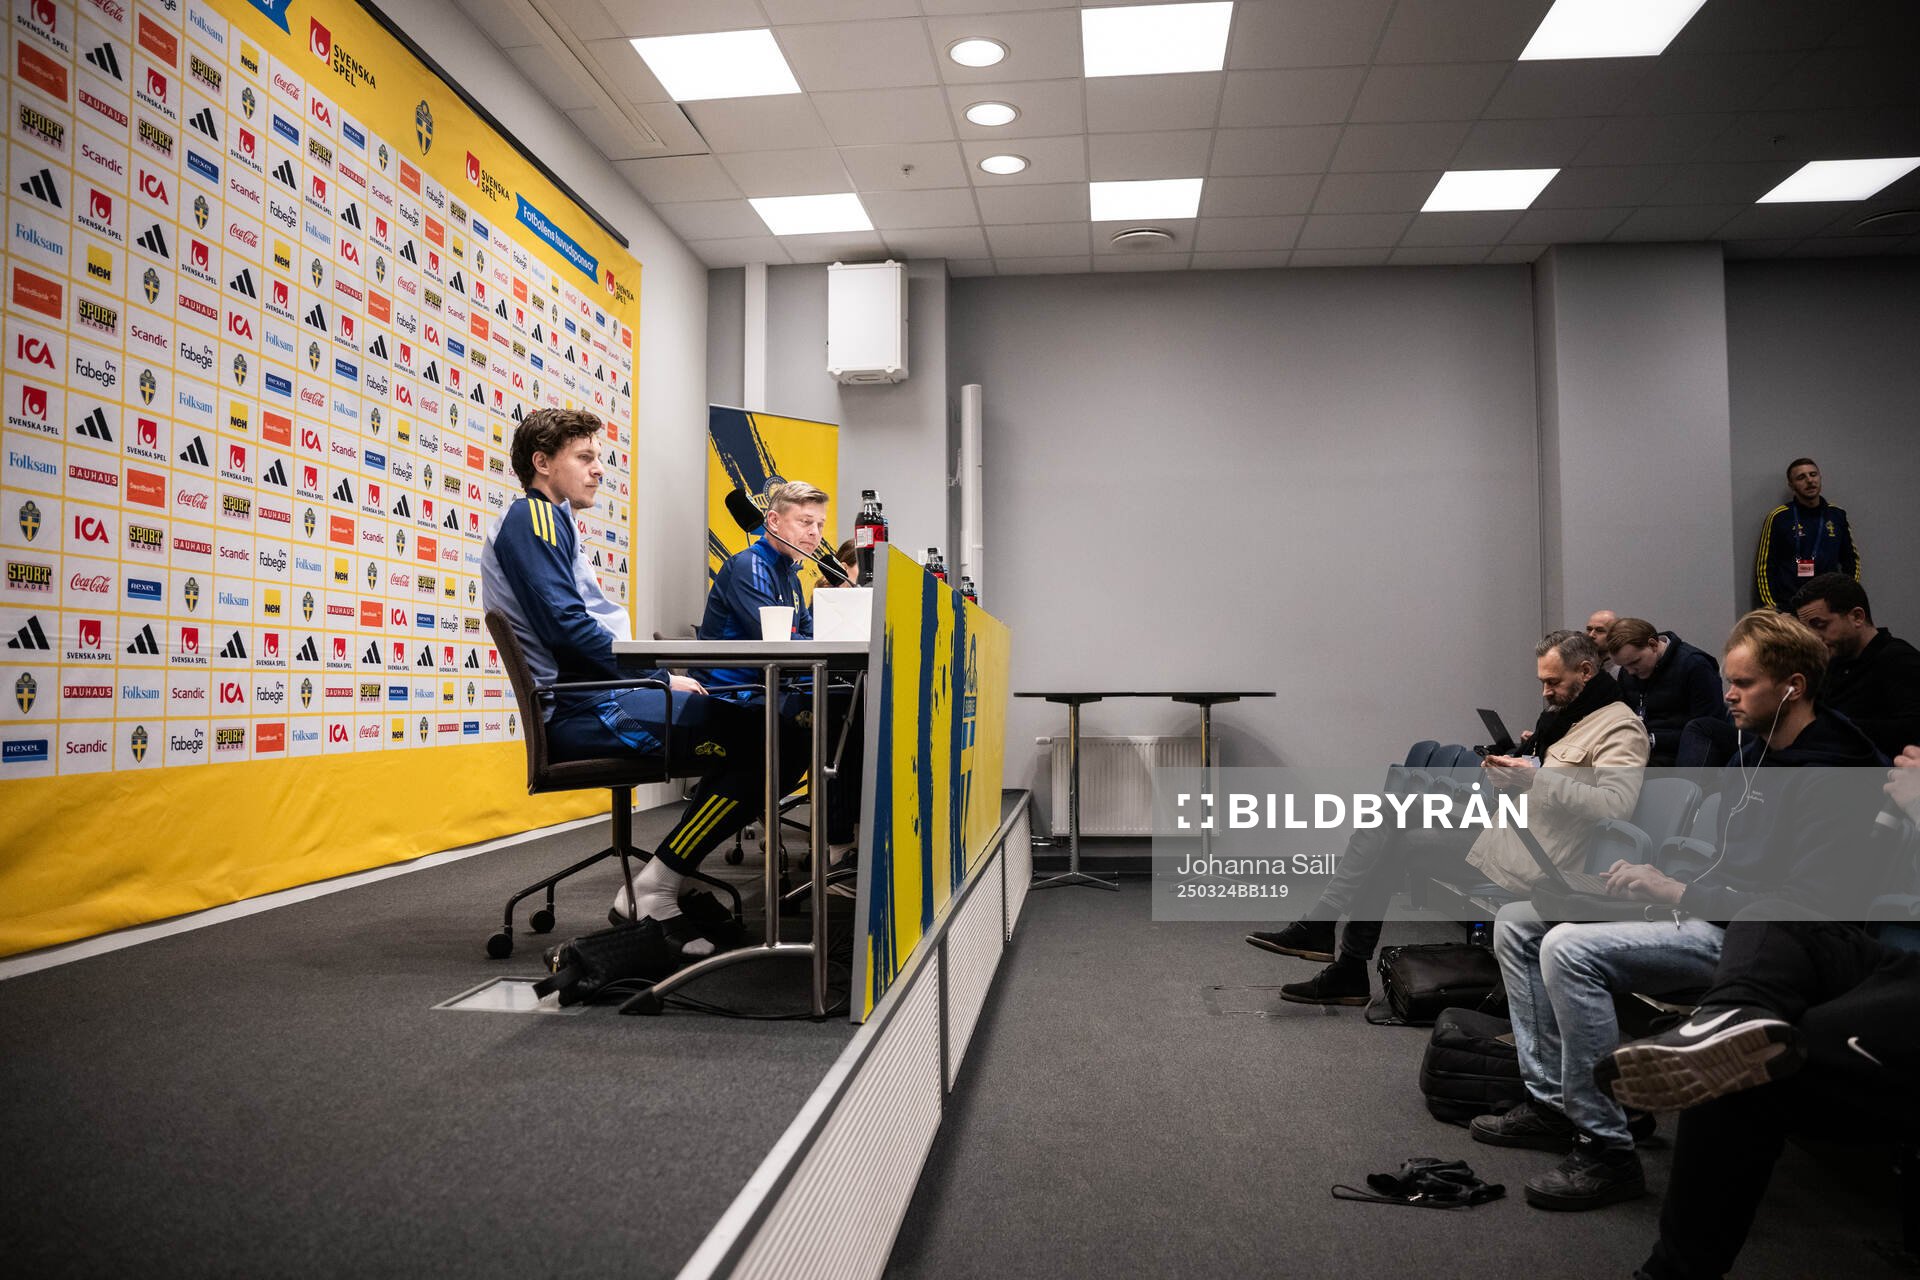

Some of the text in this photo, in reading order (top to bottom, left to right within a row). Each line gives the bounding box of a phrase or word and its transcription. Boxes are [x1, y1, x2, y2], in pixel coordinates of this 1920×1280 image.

[17, 16, 69, 53] SVENSKA SPEL
[189, 10, 223, 44] Folksam
[191, 54, 221, 82] SPORT
[334, 45, 376, 89] SVENSKA
[334, 61, 356, 88] SPEL
[80, 92, 127, 125] BAUHAUS
[137, 91, 176, 119] SVENSKA SPEL
[312, 98, 331, 128] ICA
[20, 104, 64, 136] SPORT
[139, 118, 172, 149] SPORT
[82, 144, 122, 175] Scandic
[231, 150, 251, 166] SVENSKA
[139, 169, 168, 205] ICA
[231, 179, 260, 204] Scandic
[482, 170, 510, 200] SVENSKA
[482, 183, 496, 202] SPEL
[372, 186, 392, 207] Scandic
[426, 186, 444, 208] Fabege
[270, 201, 296, 227] Fabege
[400, 205, 419, 226] Fabege
[16, 223, 63, 255] Folksam
[78, 216, 122, 242] SVENSKA SPEL
[306, 221, 330, 245] Folksam
[524, 206, 555, 241] Fotbollens
[555, 231, 594, 272] huvudsponsor
[341, 240, 359, 266] ICA
[182, 264, 217, 285] SVENSKA SPEL
[336, 281, 362, 301] BAUHAUS
[78, 299, 117, 327] SPORT
[179, 296, 217, 319] BAUHAUS
[266, 303, 284, 316] SVENSKA
[448, 306, 465, 322] Scandic
[581, 300, 590, 318] ICA
[229, 312, 252, 340] ICA
[397, 313, 416, 333] Fabege
[131, 325, 168, 349] Scandic
[266, 331, 293, 352] Folksam
[425, 324, 439, 346] ICA
[18, 334, 55, 369] ICA
[181, 343, 212, 369] Fabege
[76, 358, 115, 387] Fabege
[513, 371, 524, 391] ICA
[367, 375, 387, 396] Fabege
[396, 384, 412, 406] ICA
[179, 392, 212, 414] Folksam
[334, 401, 357, 419] Folksam
[9, 416, 59, 435] SVENSKA SPEL
[302, 428, 321, 452] ICA
[420, 434, 438, 453] Fabege
[443, 443, 463, 457] Scandic
[127, 446, 166, 462] SVENSKA SPEL
[332, 442, 356, 459] Scandic
[9, 452, 56, 475] Folksam
[393, 462, 412, 481] Fabege
[70, 466, 118, 485] BAUHAUS
[221, 470, 242, 480] SVENSKA
[296, 489, 313, 499] SVENSKA
[468, 483, 481, 500] ICA
[223, 495, 250, 513] SPORT
[259, 508, 290, 522] BAUHAUS
[75, 516, 109, 544] ICA
[129, 525, 163, 545] SPORT
[363, 531, 384, 543] Scandic
[131, 543, 161, 552] BLADET
[174, 539, 211, 553] BAUHAUS
[220, 546, 250, 561] Scandic
[260, 552, 286, 571] Fabege
[296, 558, 321, 572] Folksam
[8, 563, 52, 583] SPORT
[418, 575, 435, 589] SPORT
[10, 581, 49, 591] BLADET
[219, 592, 249, 606] Folksam
[328, 606, 354, 616] BAUHAUS
[391, 608, 407, 626] ICA
[441, 616, 458, 632] Fabege
[67, 651, 95, 660] SVENSKA
[64, 687, 112, 697] BAUHAUS
[123, 686, 160, 699] Folksam
[172, 688, 204, 699] Scandic
[220, 682, 244, 704] ICA
[257, 687, 283, 704] Fabege
[326, 689, 352, 697] BAUHAUS
[361, 684, 380, 697] SPORT
[415, 689, 434, 698] Folksam
[217, 728, 244, 744] SPORT
[292, 729, 318, 741] Folksam
[329, 724, 348, 743] ICA
[438, 724, 459, 732] BAUHAUS
[67, 740, 107, 754] Scandic
[171, 737, 203, 753] Fabege
